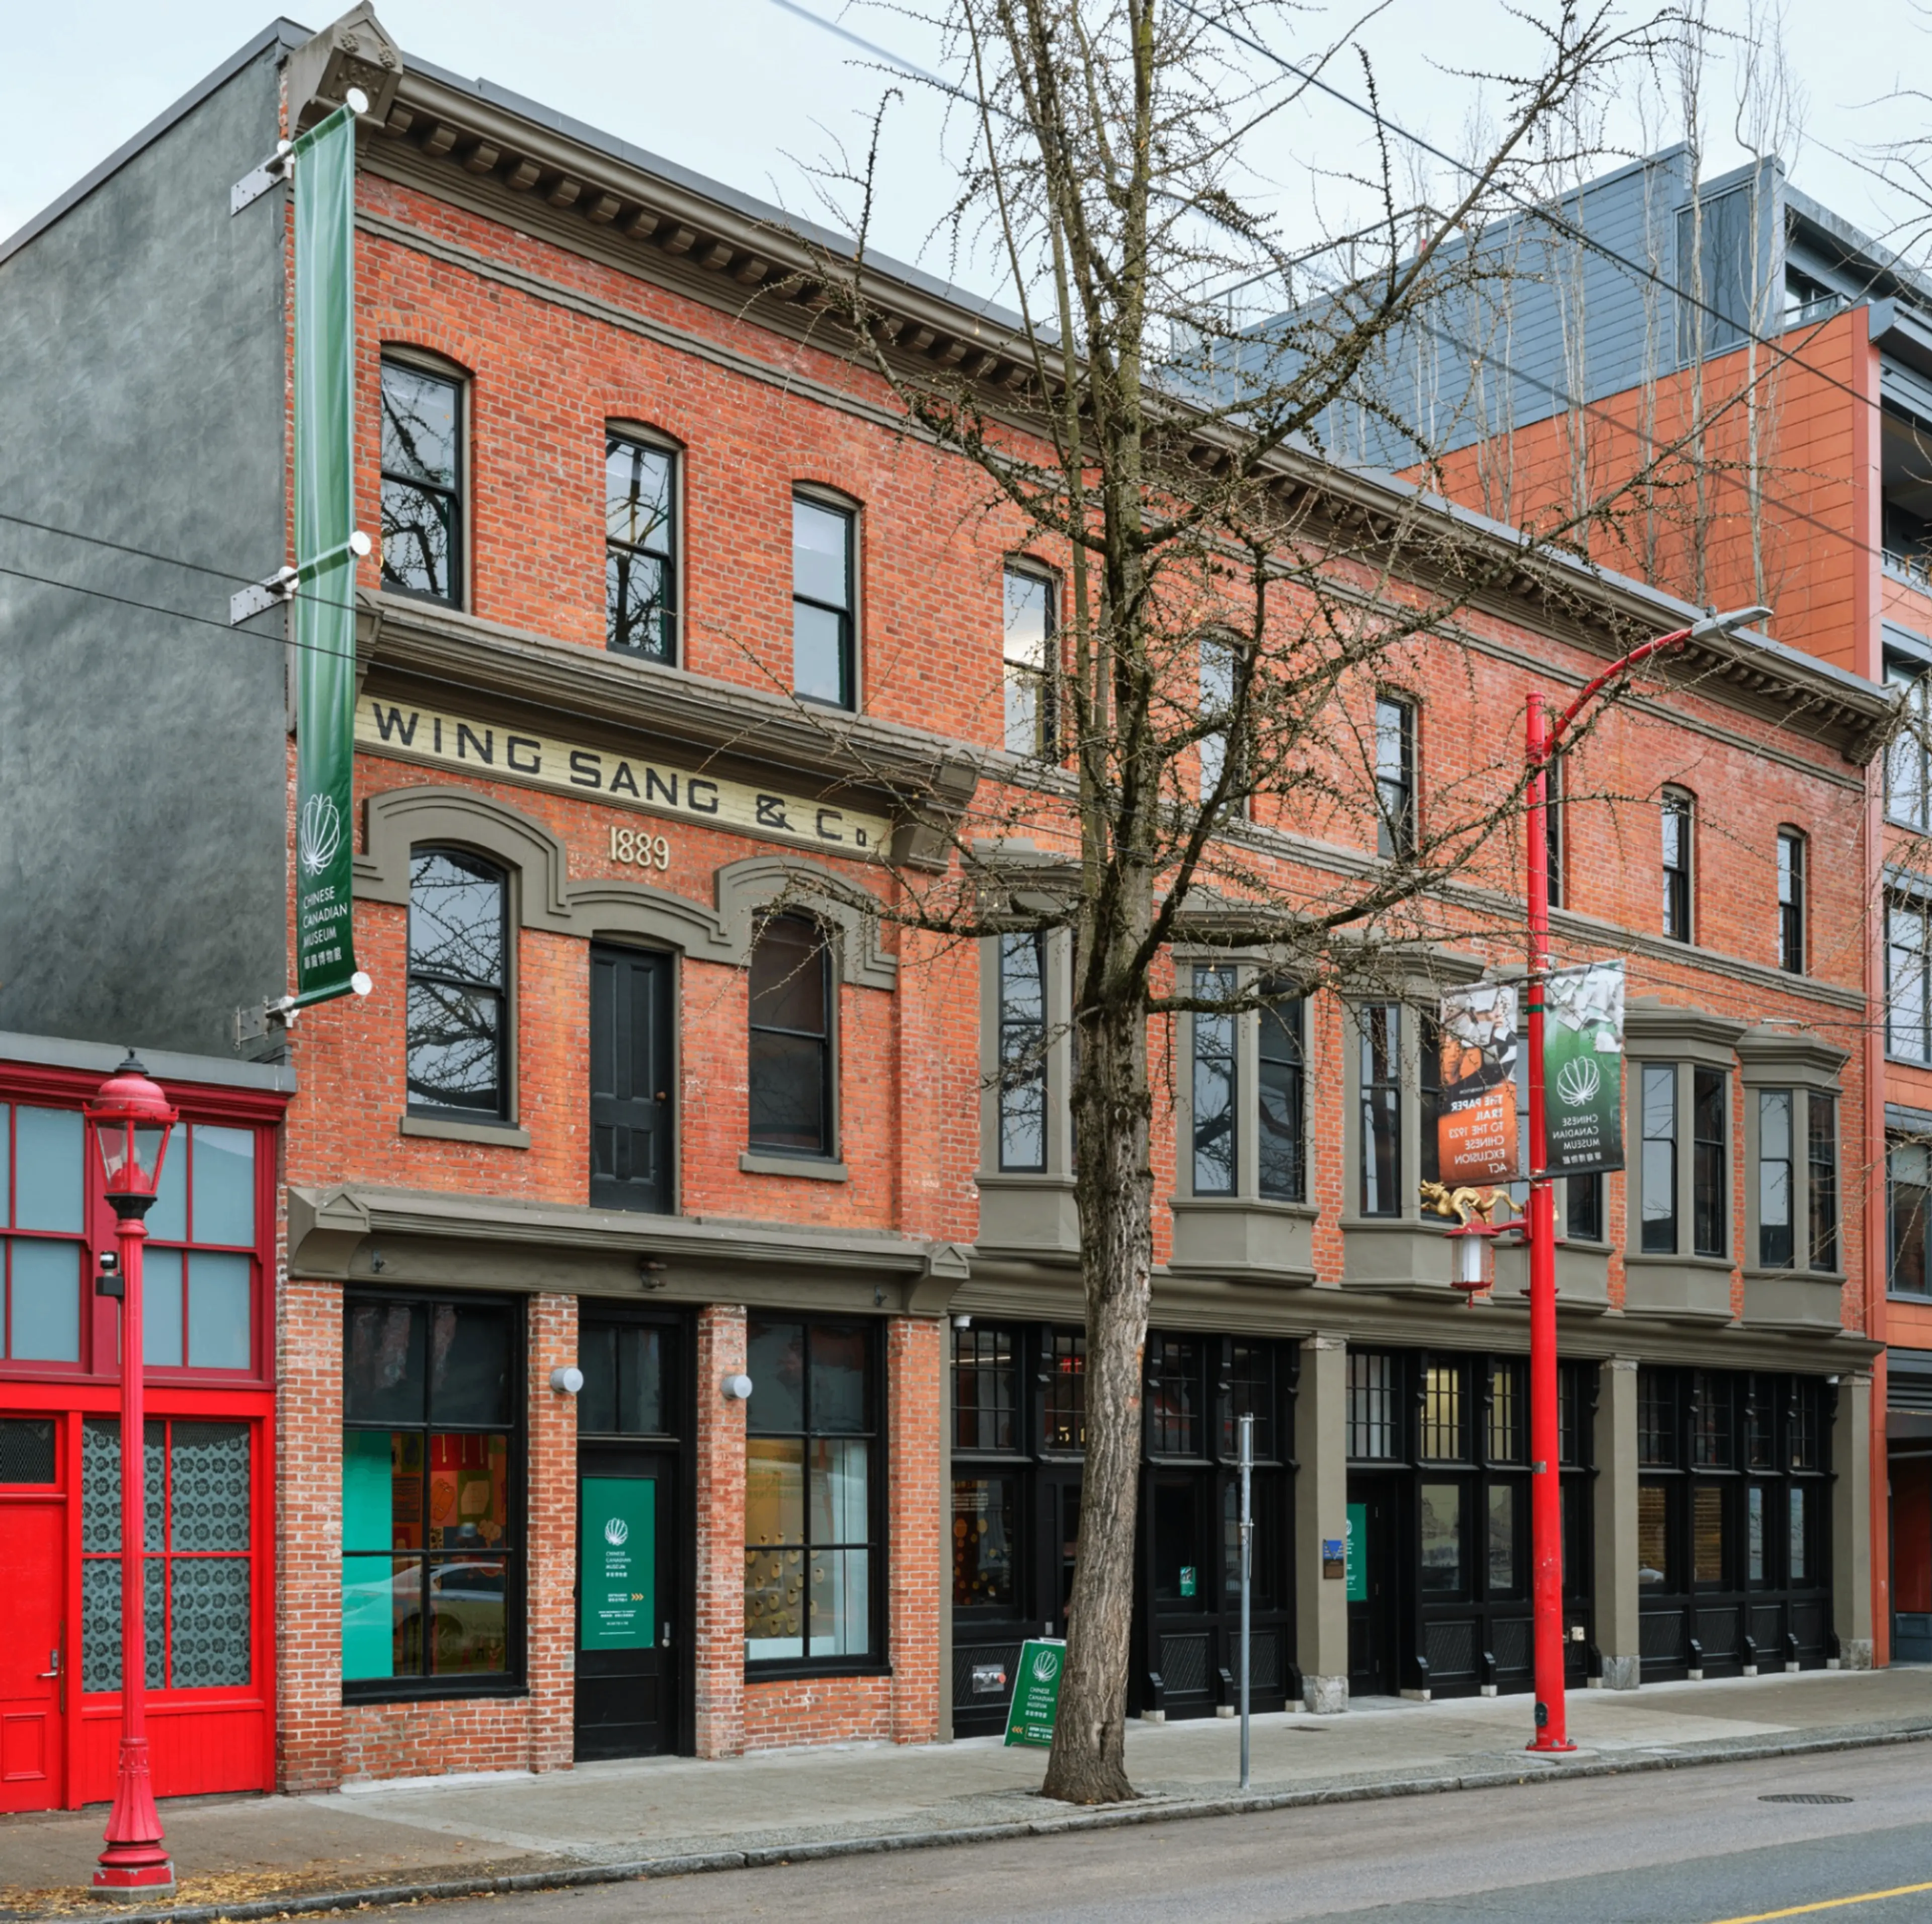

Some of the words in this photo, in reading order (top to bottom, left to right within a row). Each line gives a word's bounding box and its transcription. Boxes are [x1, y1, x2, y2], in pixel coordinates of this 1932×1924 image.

[372, 702, 542, 775] WING
[570, 750, 719, 816] SANG
[756, 793, 794, 831] &
[610, 825, 670, 871] 1889
[303, 886, 336, 910] CHINESE
[302, 903, 348, 929] CANADIAN
[303, 925, 337, 948] MUSEUM
[1028, 1694, 1055, 1703] CANADIAN
[1029, 1687, 1050, 1695] CHINESE
